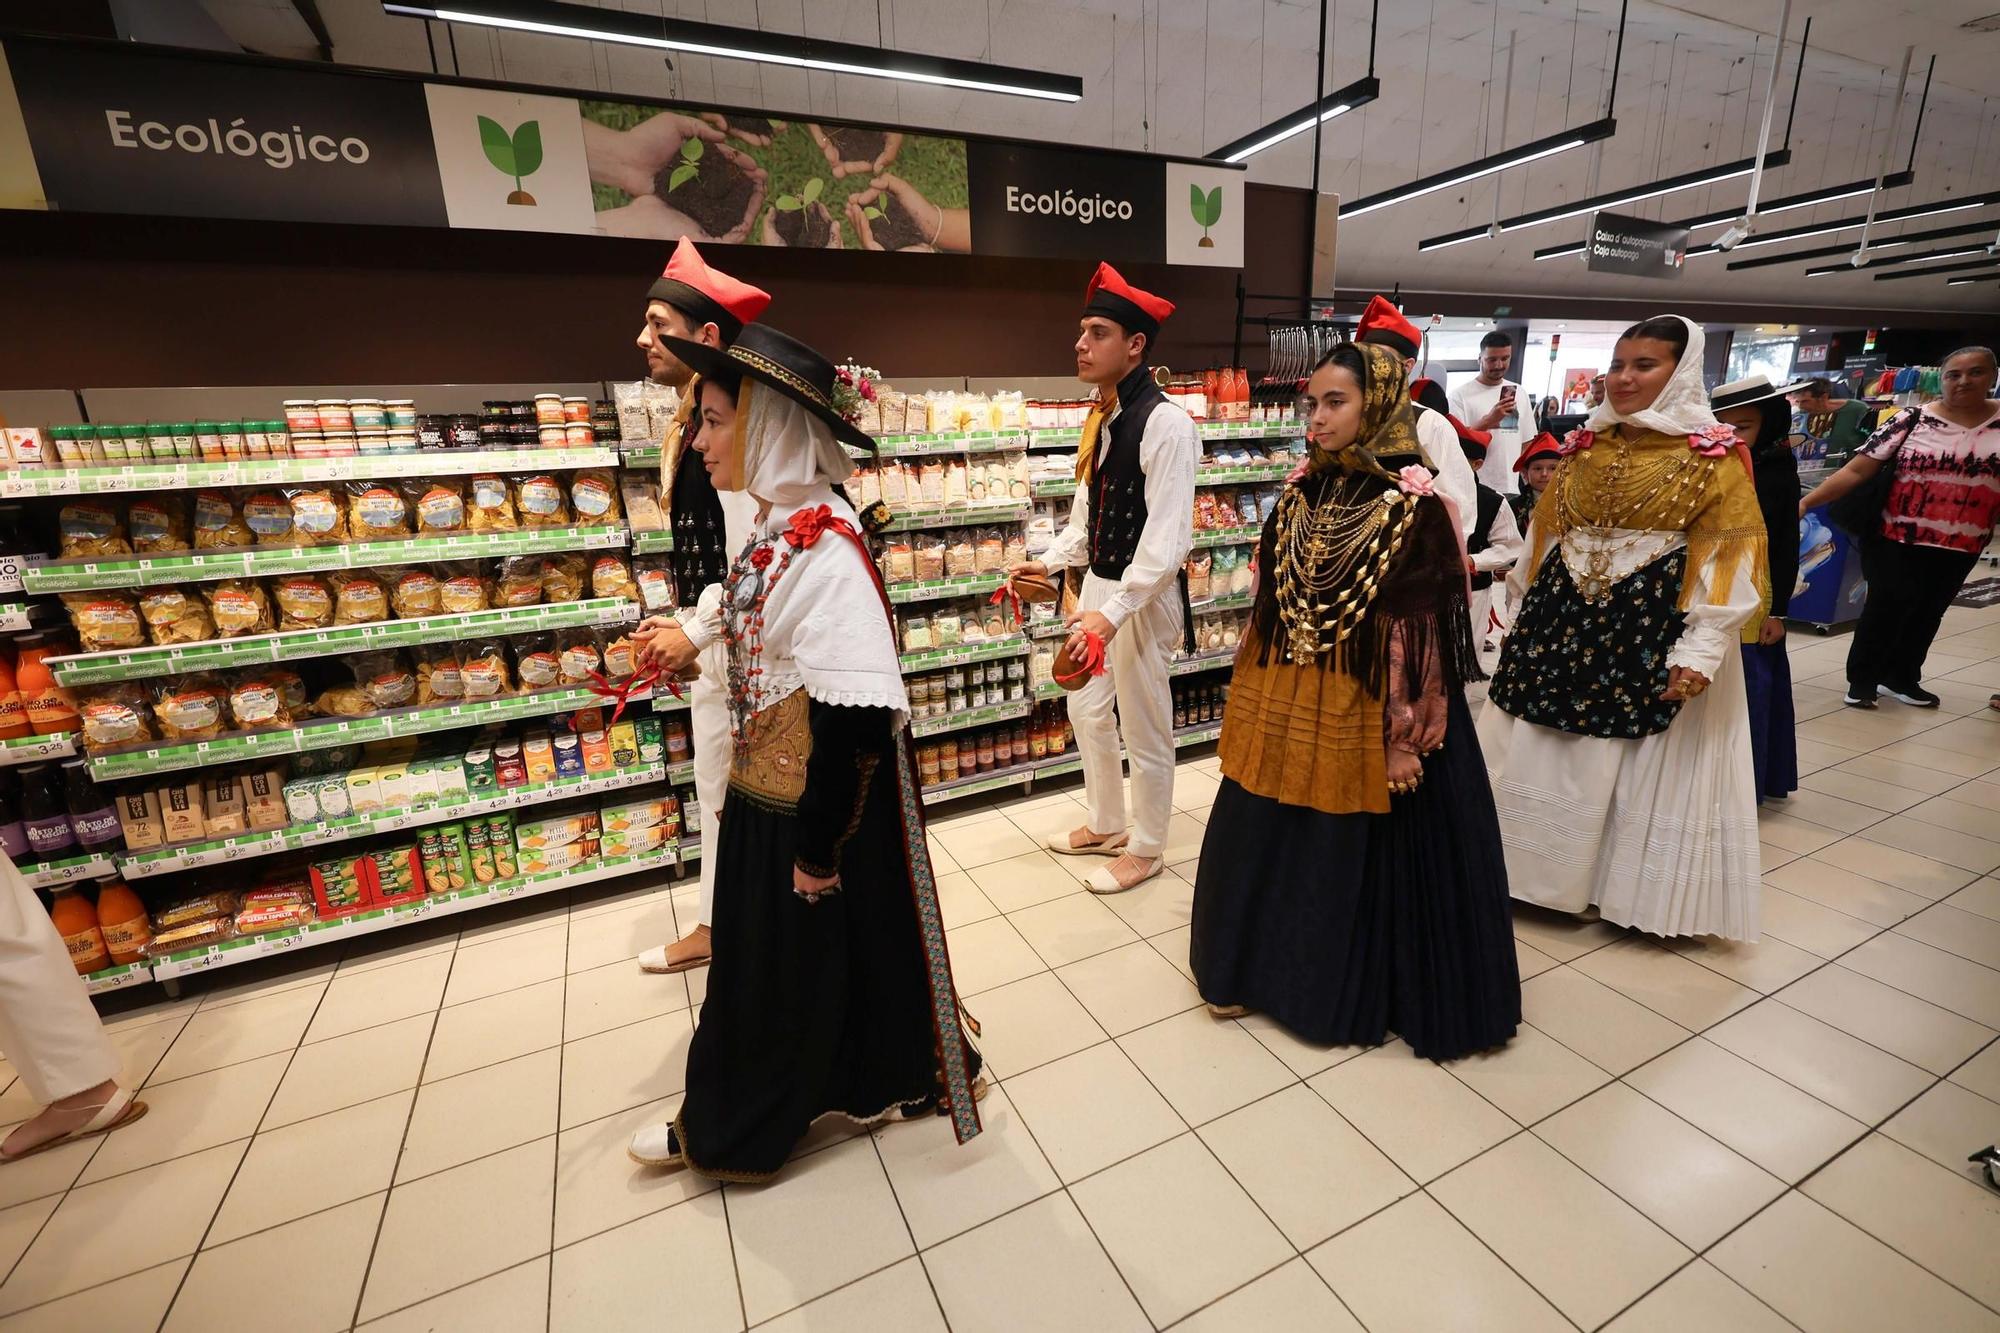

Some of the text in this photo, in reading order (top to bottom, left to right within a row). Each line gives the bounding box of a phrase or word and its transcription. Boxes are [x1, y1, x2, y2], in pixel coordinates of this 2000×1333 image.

[105, 110, 370, 168] Ecológico
[1006, 186, 1133, 224] Ecológico
[1596, 230, 1614, 243] Caixa
[1594, 244, 1640, 262] Caja autopago
[35, 580, 79, 590] ecológico
[93, 576, 135, 586] ecológico
[125, 667, 166, 677] ecológico
[69, 674, 112, 684] ecológico
[38, 743, 63, 755] 3.25
[103, 767, 143, 777] ecológico
[63, 866, 87, 878] 3.25
[283, 936, 303, 947] 3.79
[202, 954, 223, 966] 4.49
